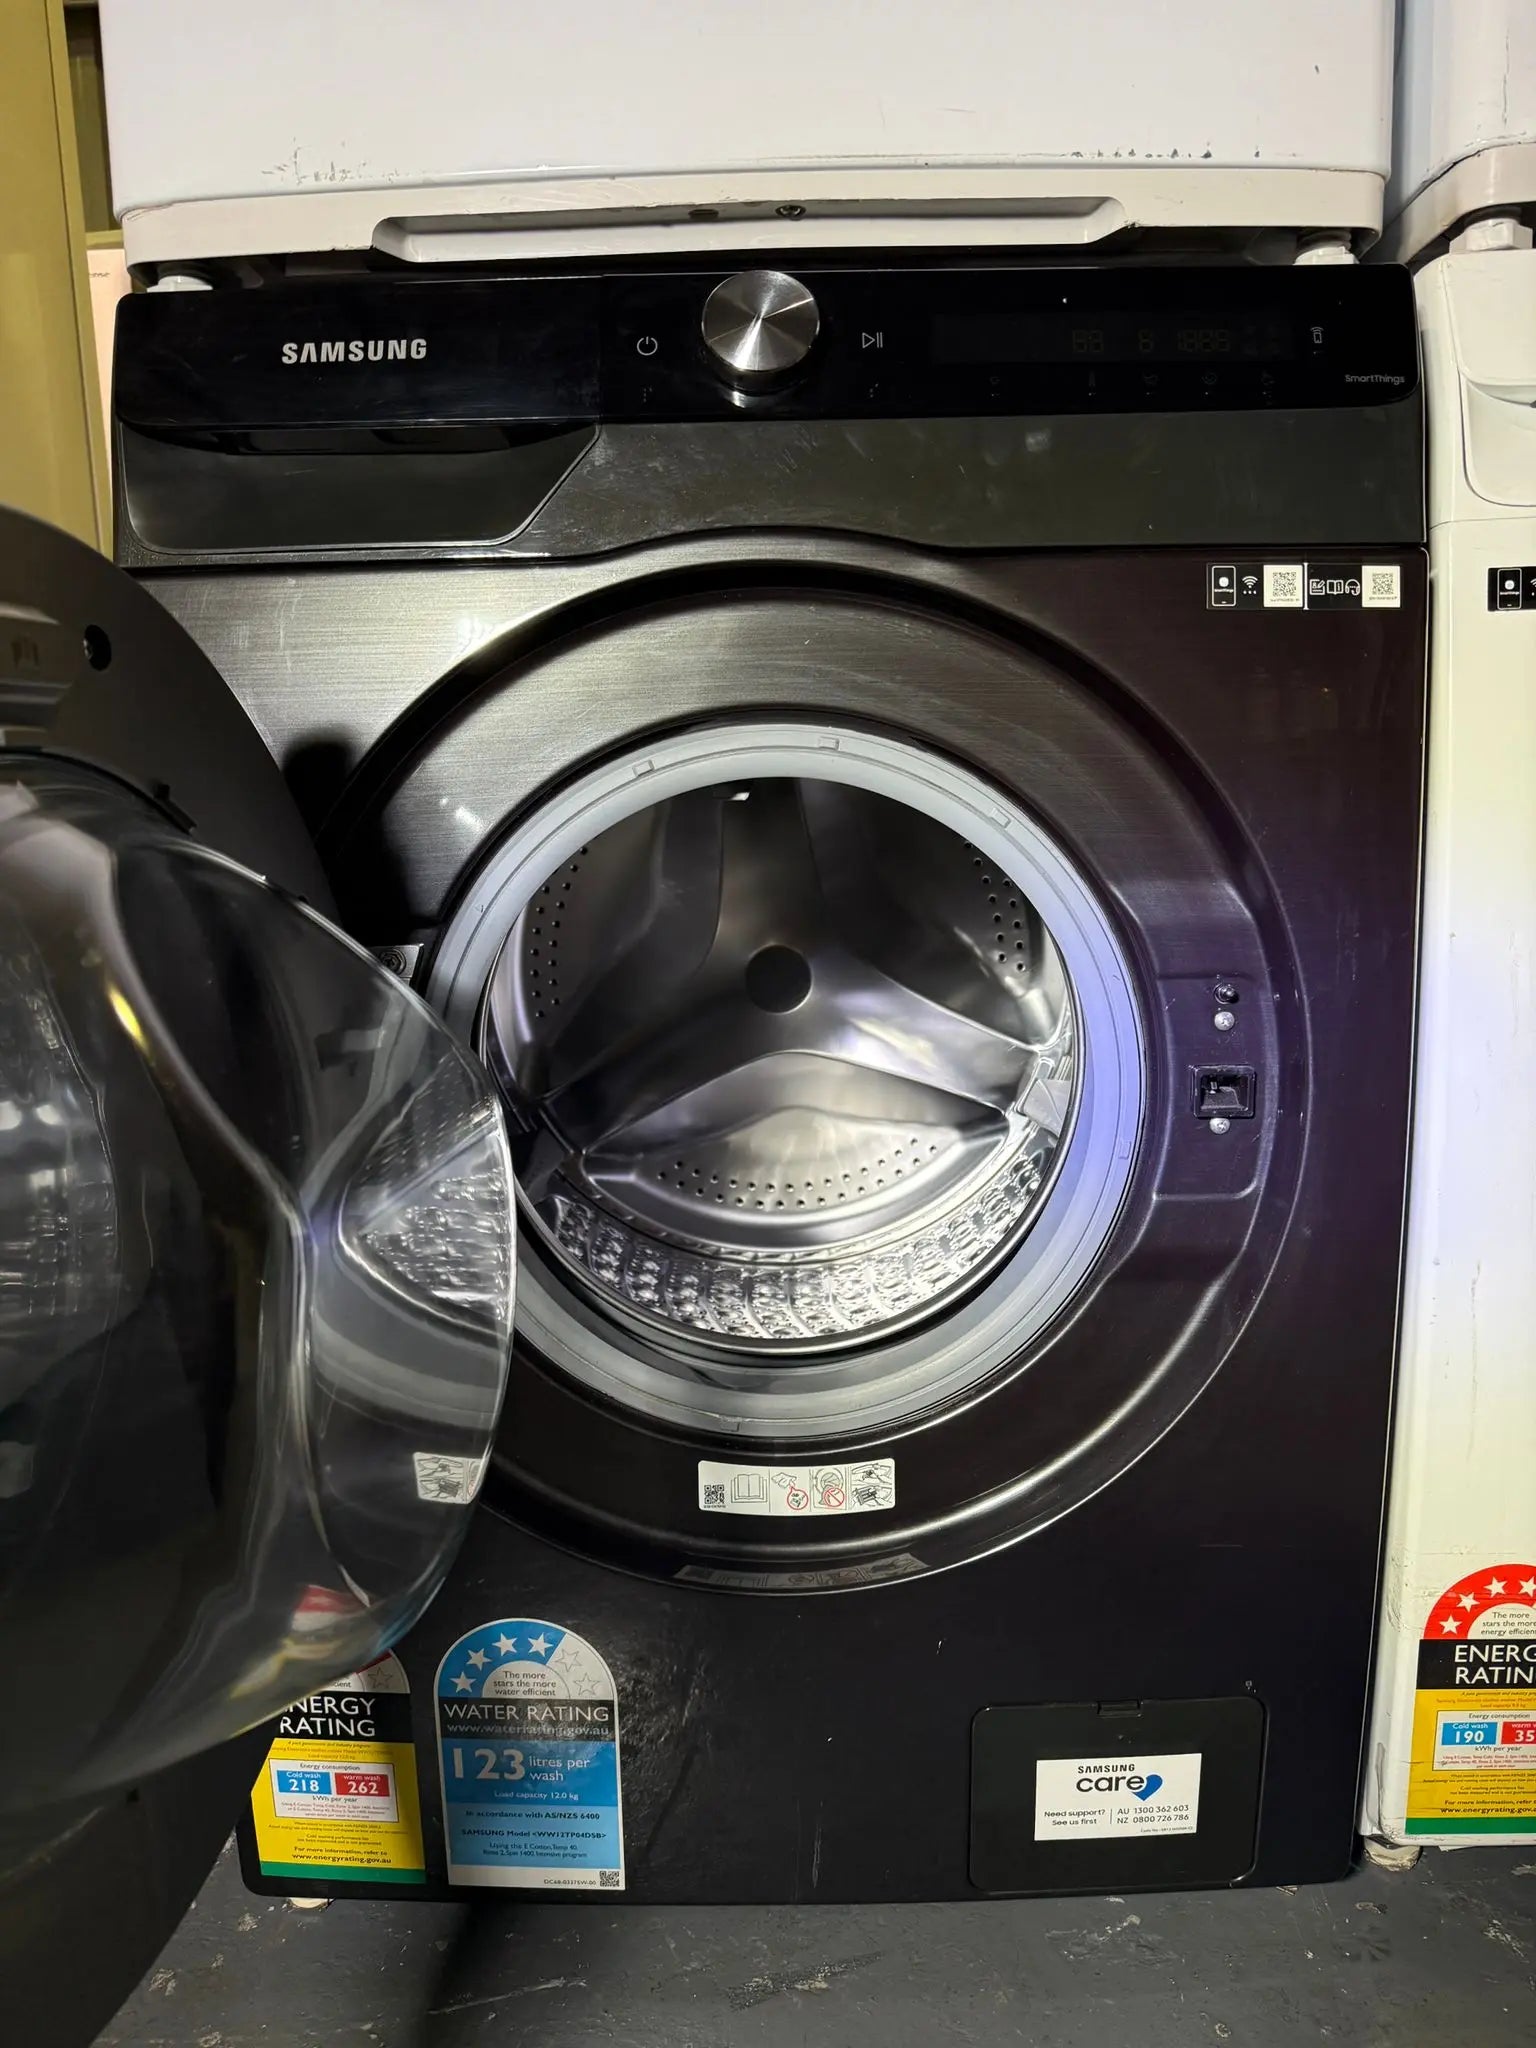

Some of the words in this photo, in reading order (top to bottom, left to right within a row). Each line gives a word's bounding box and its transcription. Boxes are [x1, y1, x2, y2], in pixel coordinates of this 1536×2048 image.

[281, 338, 427, 364] SAMSUNG
[1345, 374, 1405, 385] SmartThings
[1454, 1644, 1536, 1663] ENERG
[503, 1671, 520, 1679] The
[1455, 1666, 1536, 1684] RATIN
[495, 1688, 520, 1696] water
[522, 1688, 556, 1696] efficient
[285, 1696, 376, 1715] NERGY
[444, 1704, 520, 1720] WATER
[527, 1705, 609, 1722] RATING
[280, 1717, 376, 1737] RATING
[447, 1724, 609, 1737] www.waterrating.gov.au
[1455, 1730, 1484, 1744] 190
[1515, 1730, 1536, 1743] 35
[300, 1763, 320, 1771] Energy
[322, 1764, 360, 1772] consumption
[529, 1756, 562, 1768] litres
[567, 1759, 590, 1770] per
[1078, 1764, 1136, 1774] SAMSUNG
[530, 1771, 564, 1782] wash
[289, 1779, 319, 1792] 218
[348, 1781, 379, 1794] 262
[1076, 1775, 1145, 1793] care
[517, 1792, 548, 1800] capacity
[569, 1793, 579, 1801] kg
[1068, 1809, 1106, 1819] support?
[1173, 1804, 1189, 1812] 603
[525, 1811, 544, 1819] with
[545, 1812, 578, 1820] AS/NZS
[580, 1812, 600, 1820] 6400
[1080, 1817, 1097, 1825] first
[292, 1854, 392, 1864] www.energyrating.gov.au
